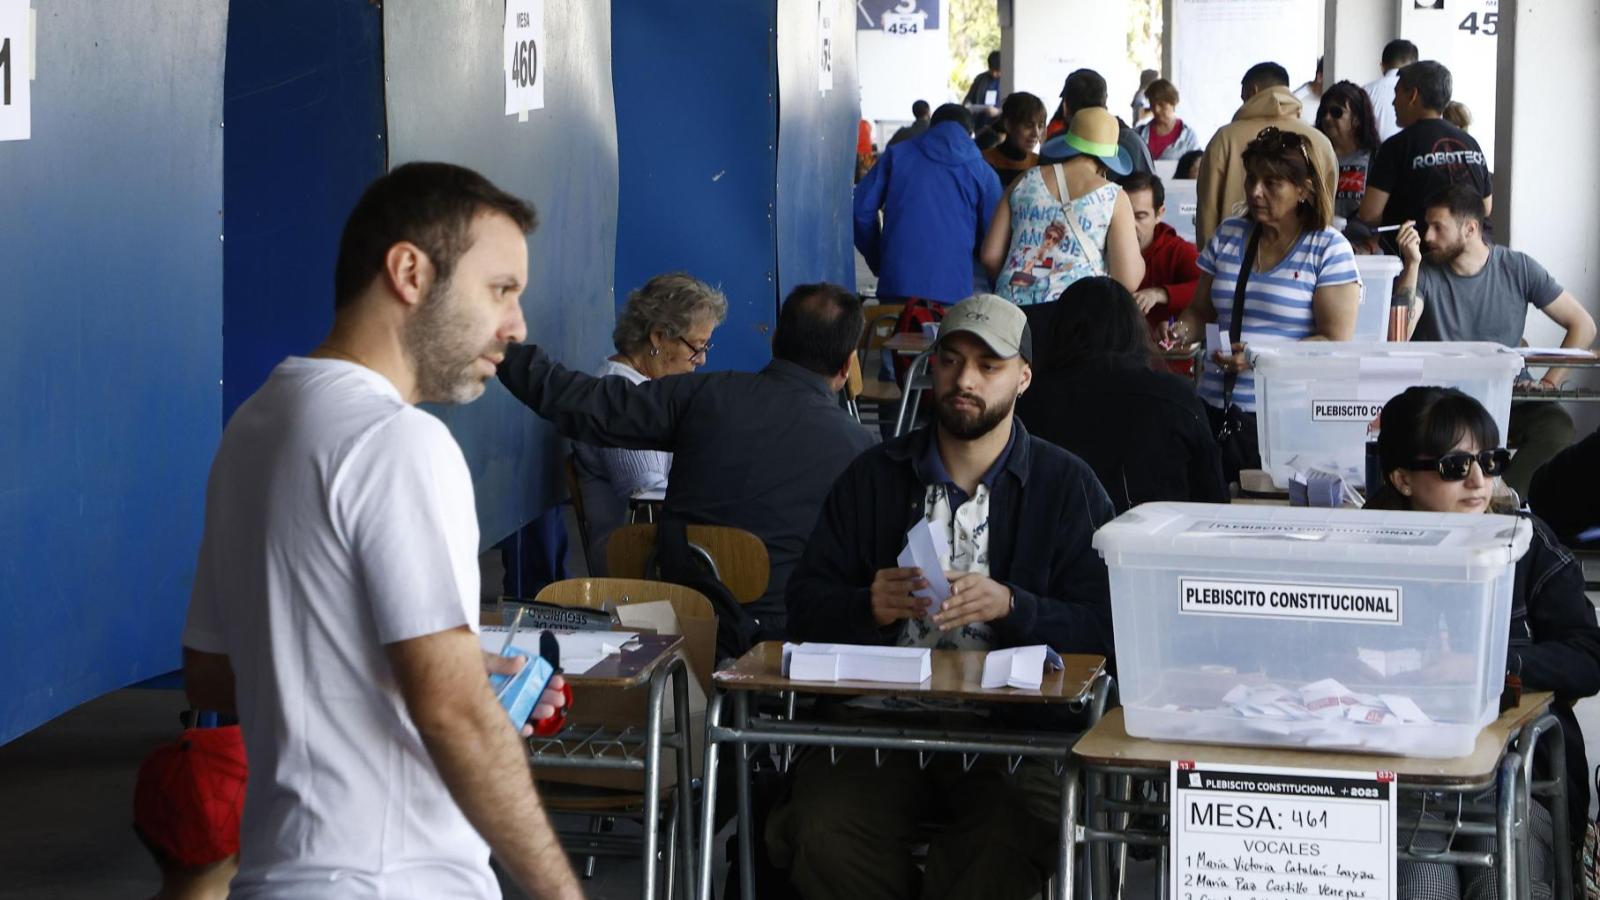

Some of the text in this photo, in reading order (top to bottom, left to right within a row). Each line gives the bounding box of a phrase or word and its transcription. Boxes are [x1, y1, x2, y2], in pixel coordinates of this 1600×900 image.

[516, 12, 530, 28] MESA
[888, 23, 918, 34] 454
[1458, 11, 1499, 36] 45
[512, 39, 537, 88] 460
[1315, 404, 1368, 417] PLEBISCITO
[1186, 587, 1394, 613] PLEBISCITO CONSTITUCIONAL
[1205, 779, 1256, 791] PLEBISCITO
[1257, 783, 1335, 795] CONSTITUCIONAL
[1350, 788, 1379, 797] 2023
[1191, 802, 1328, 830] MESA: 461
[1243, 839, 1321, 856] VOCALES
[1185, 855, 1192, 868] 1
[1233, 854, 1276, 873] Victoria
[1184, 873, 1193, 887] 2
[1265, 878, 1308, 894] Castillo
